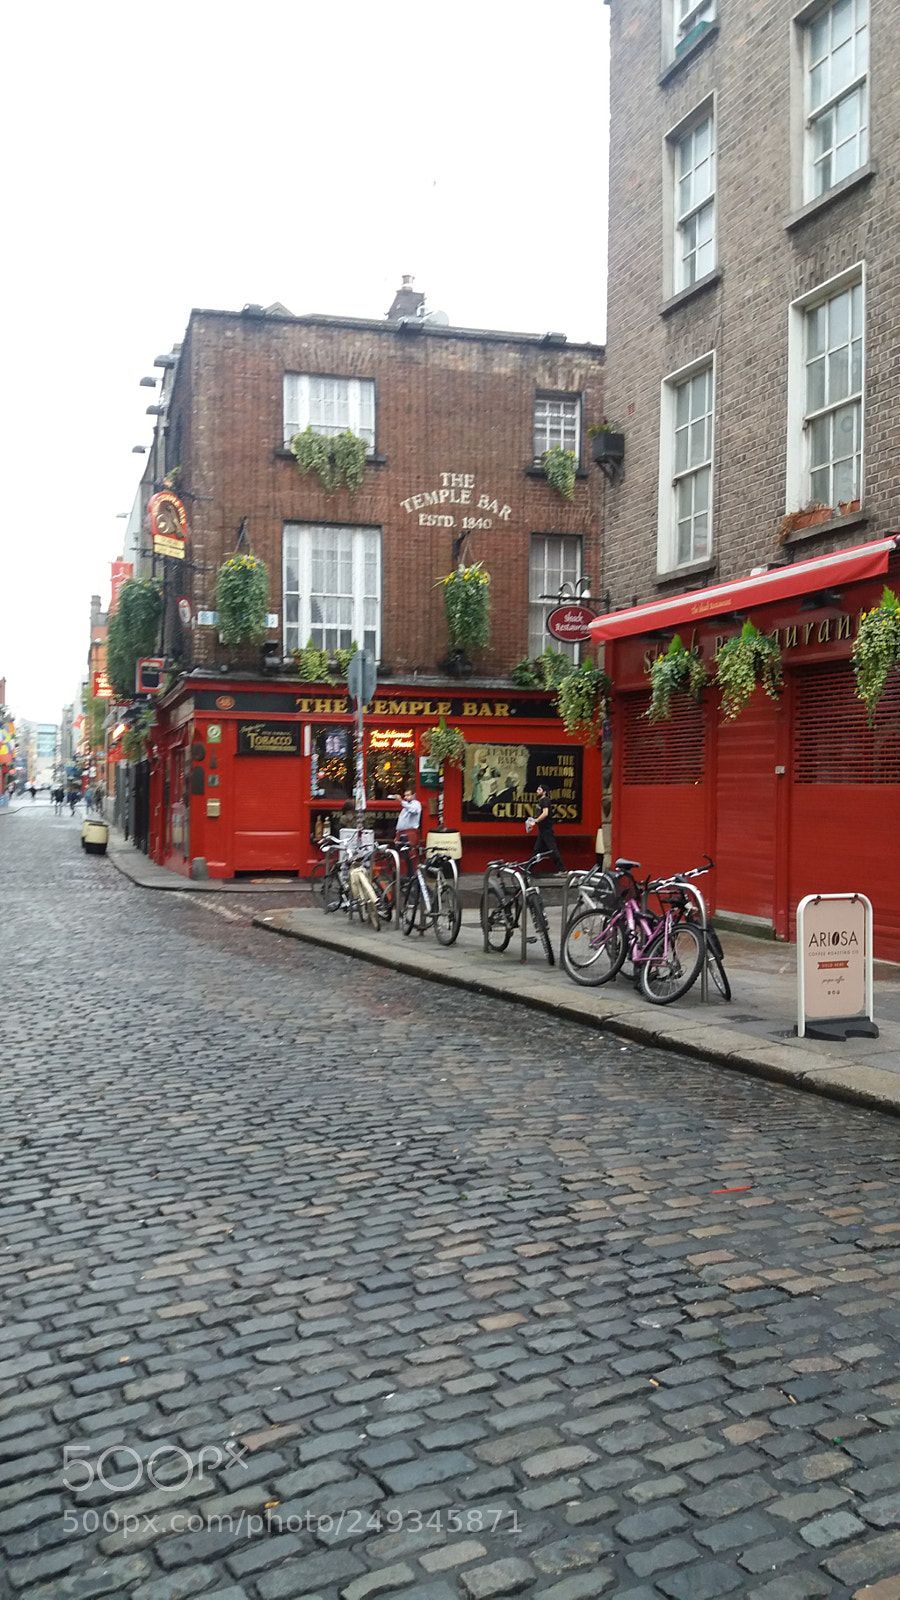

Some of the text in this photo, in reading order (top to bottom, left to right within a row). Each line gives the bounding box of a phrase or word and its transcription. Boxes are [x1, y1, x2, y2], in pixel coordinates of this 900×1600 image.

[440, 472, 475, 488] THE
[400, 489, 512, 520] TEMPLE BAR
[462, 517, 492, 529] 1840
[295, 698, 348, 714] THE
[462, 702, 510, 717] BAR
[391, 738, 415, 748] Music
[557, 755, 574, 765] THE
[536, 766, 574, 777] EMPEROR
[808, 931, 858, 947] ARIOSA
